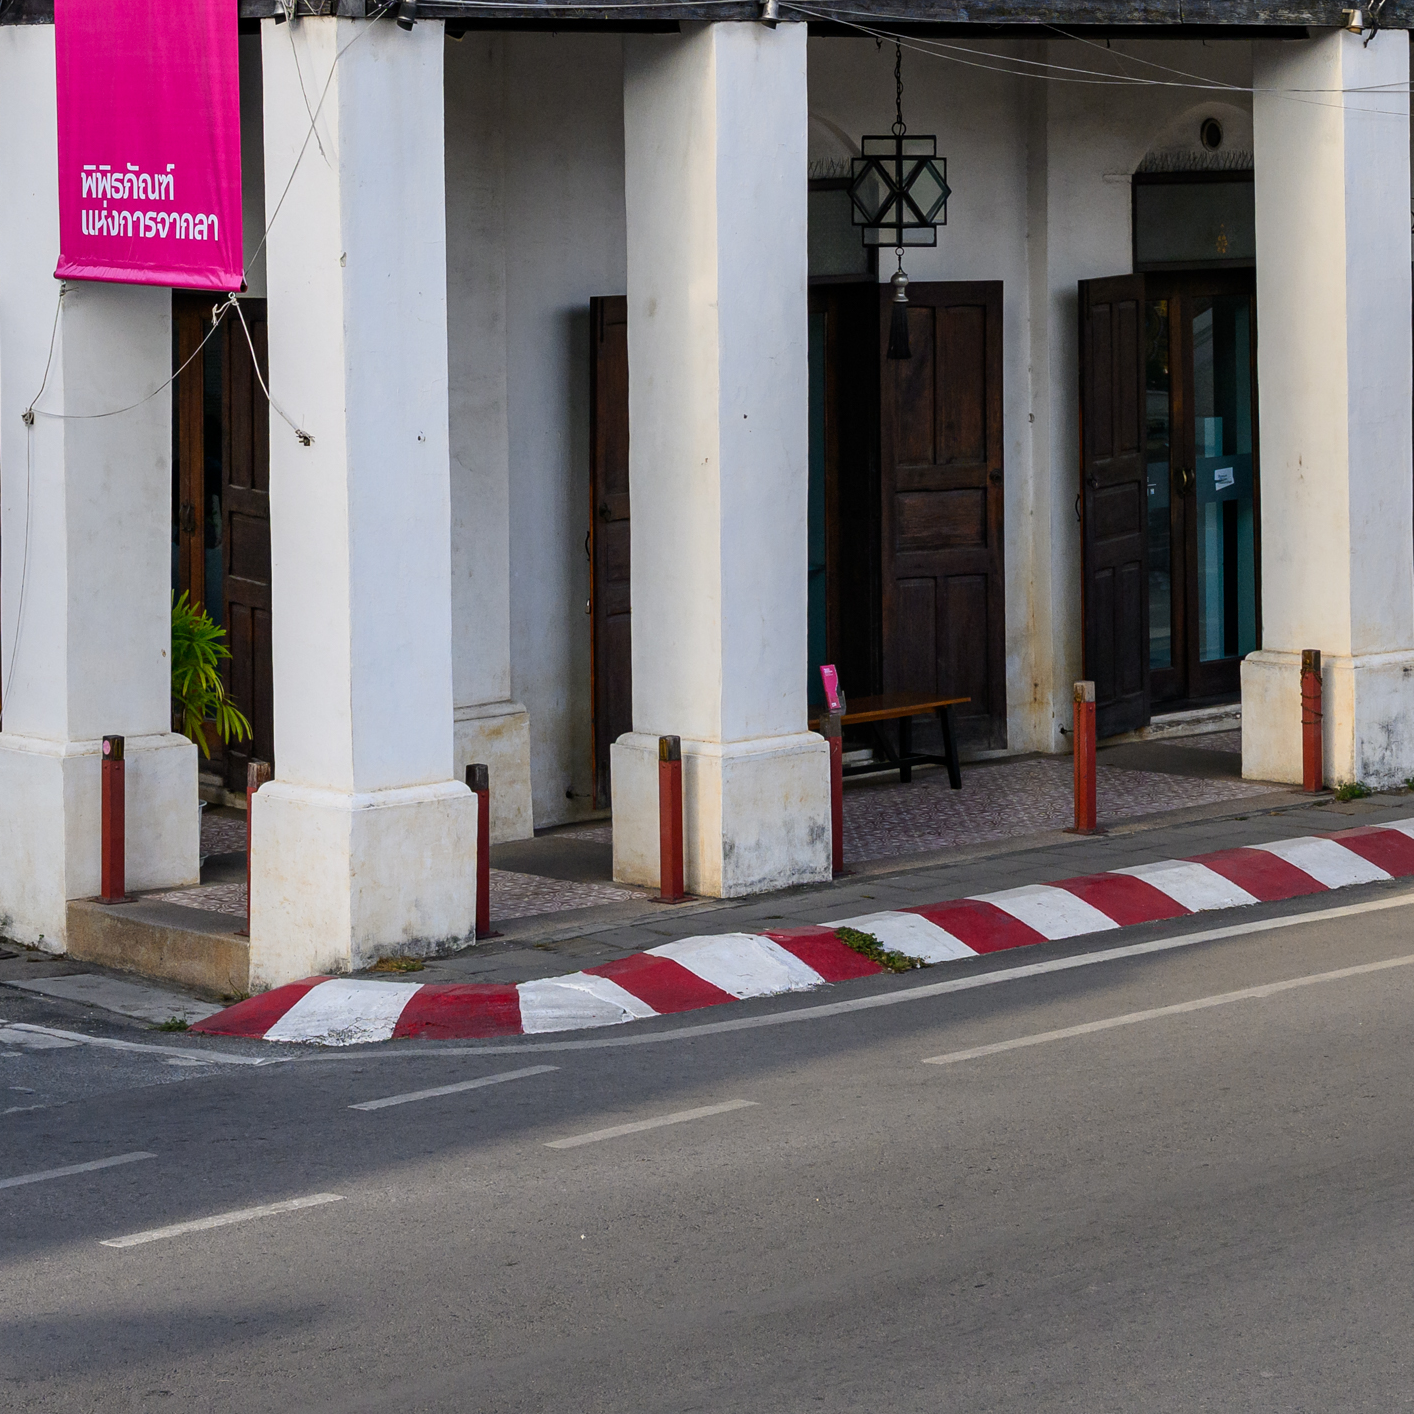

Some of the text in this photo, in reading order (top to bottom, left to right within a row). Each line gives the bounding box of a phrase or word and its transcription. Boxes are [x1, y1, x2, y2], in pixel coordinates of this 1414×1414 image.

[81, 162, 175, 201] พิพิธภัณฑ์
[81, 199, 219, 241] แห่งการจากลา
